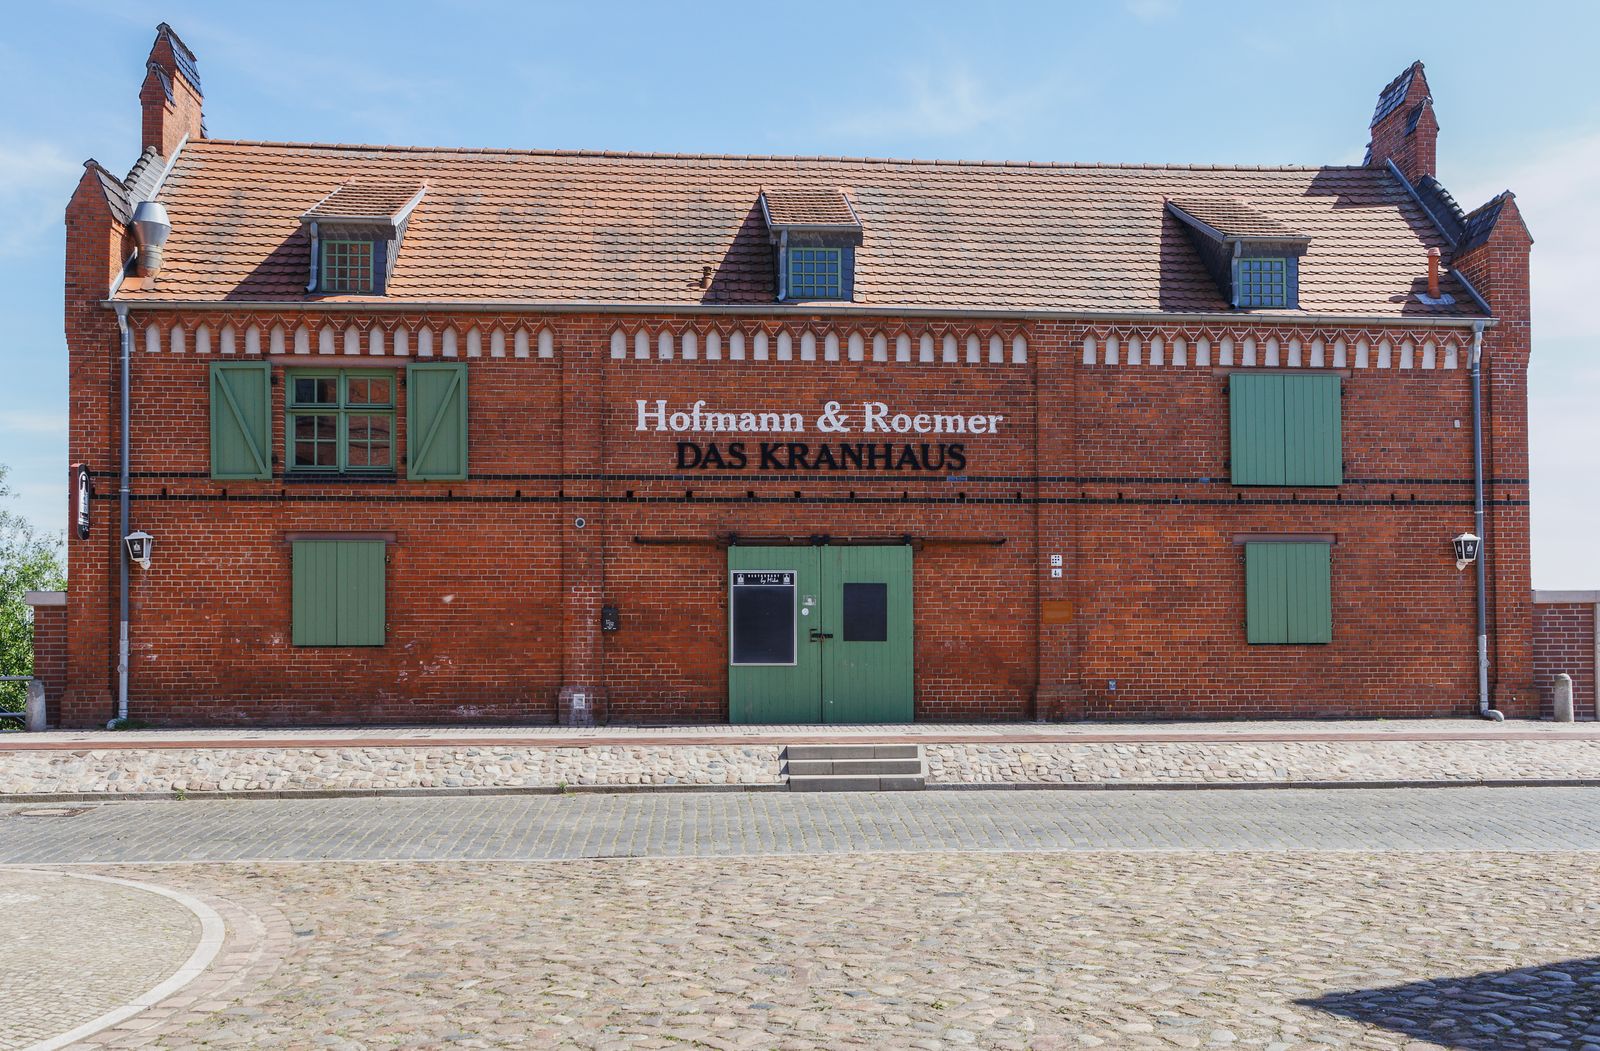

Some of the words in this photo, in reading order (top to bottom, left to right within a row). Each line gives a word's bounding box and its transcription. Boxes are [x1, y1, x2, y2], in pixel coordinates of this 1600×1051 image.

[635, 399, 805, 432] Hofmann
[816, 400, 851, 433] &
[862, 401, 1004, 434] Roemer
[676, 442, 747, 470] DAS
[758, 442, 967, 472] KRANHAUS
